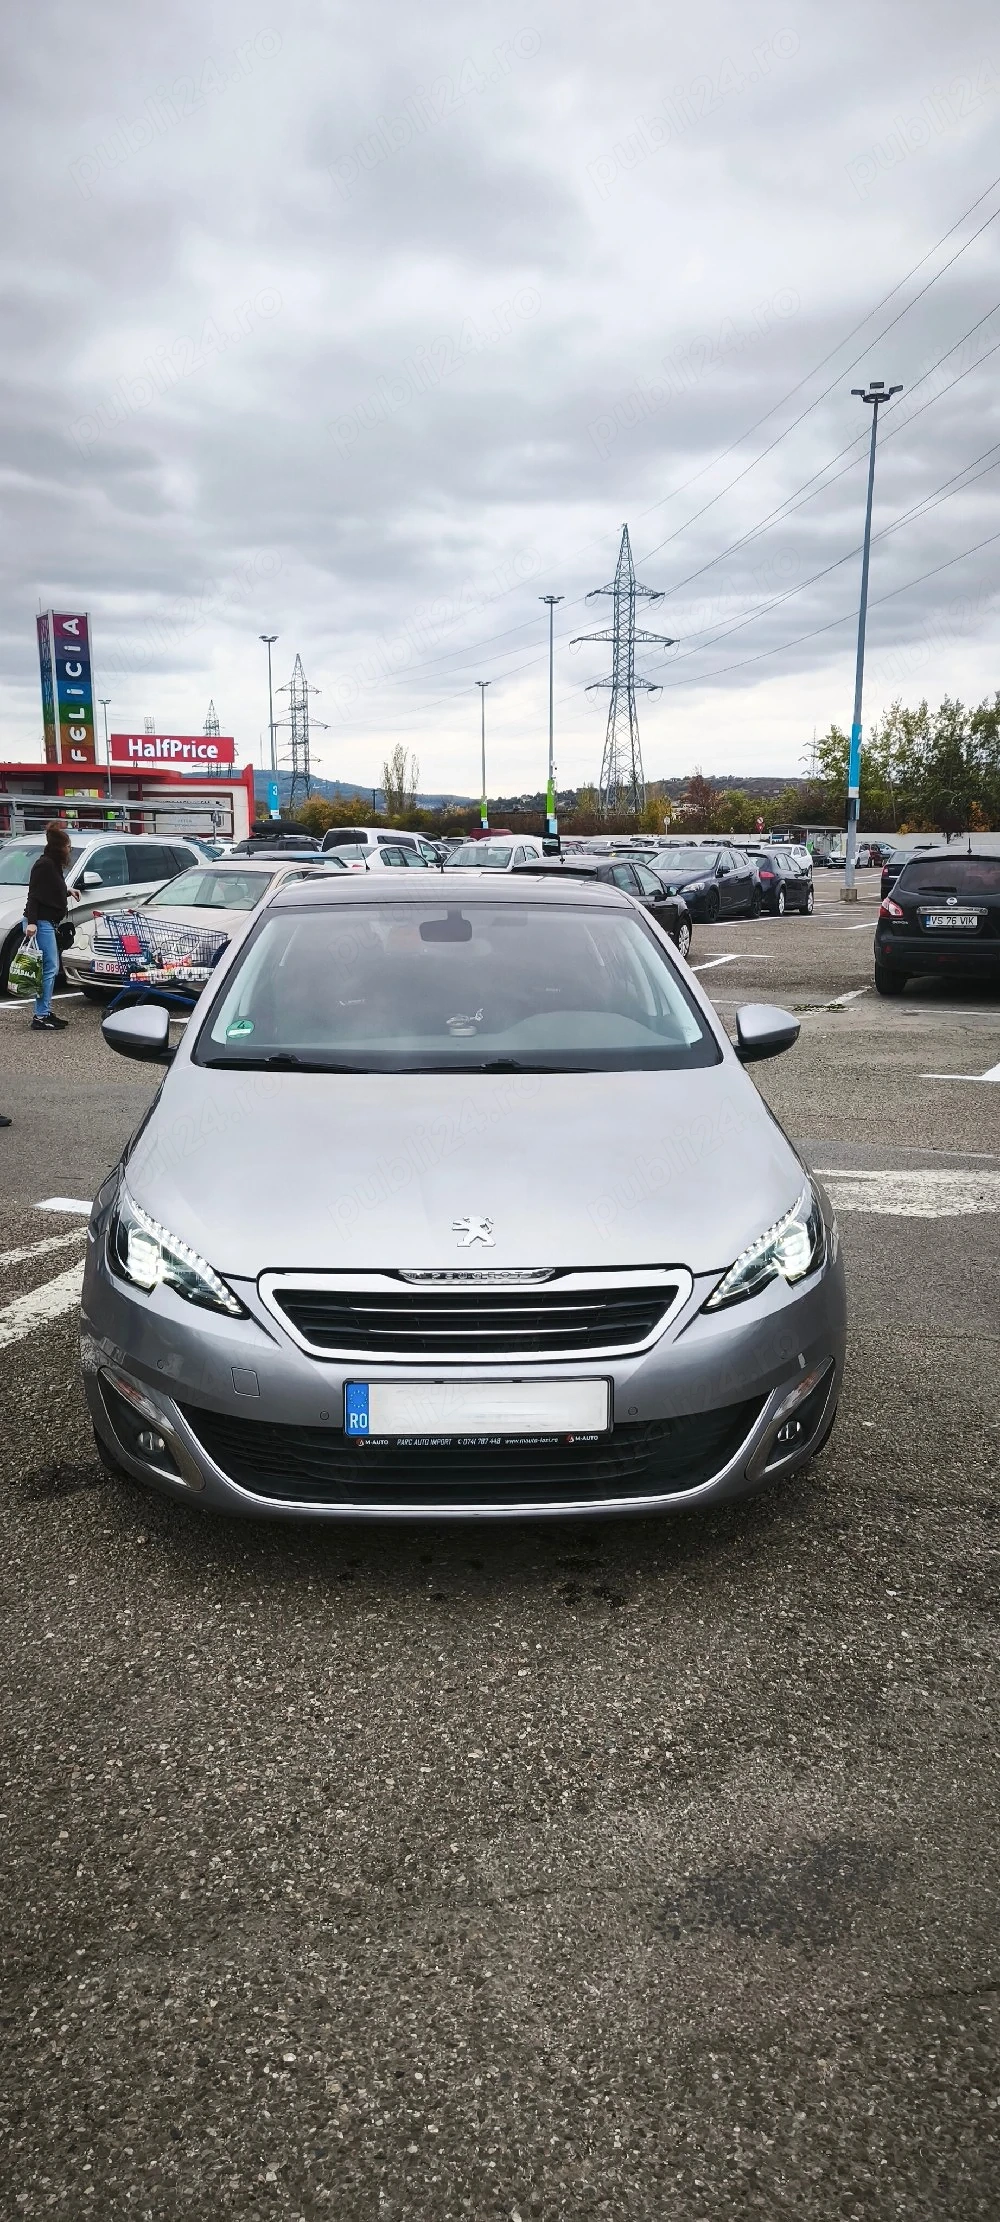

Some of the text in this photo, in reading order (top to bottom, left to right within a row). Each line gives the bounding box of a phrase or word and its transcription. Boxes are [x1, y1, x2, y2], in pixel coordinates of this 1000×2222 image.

[128, 738, 219, 759] HalfPrice
[931, 916, 975, 925] VS 76 VIK
[431, 1271, 523, 1280] PEUGEOT
[349, 1412, 368, 1429] RO
[396, 1438, 413, 1446] PARC
[413, 1438, 429, 1446] AUTO
